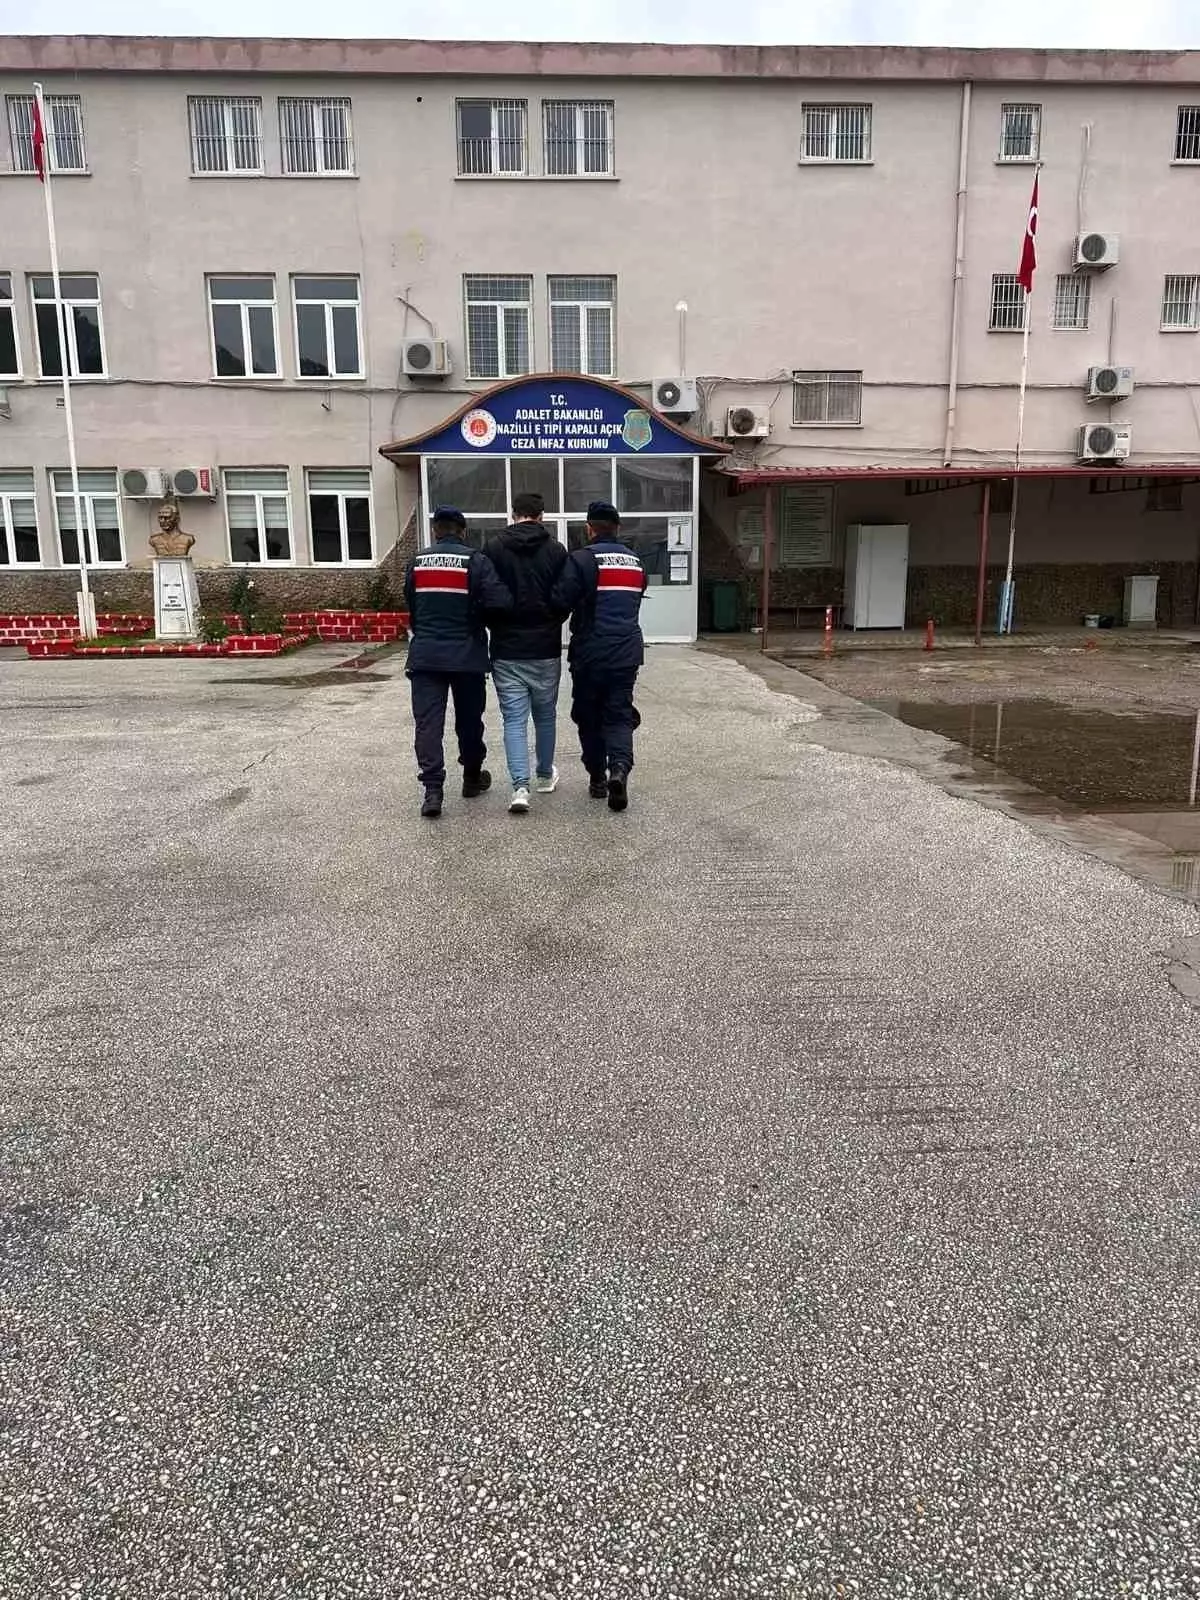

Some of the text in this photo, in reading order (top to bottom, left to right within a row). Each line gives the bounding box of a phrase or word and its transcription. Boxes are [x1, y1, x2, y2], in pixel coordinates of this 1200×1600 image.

[550, 394, 568, 406] T.C.
[515, 407, 603, 420] ADALET BAKANLIĞI
[496, 422, 532, 435] NAZİLLİ
[535, 424, 541, 435] E
[565, 423, 598, 435] KAPALI
[600, 423, 623, 438] AÇIK
[511, 436, 609, 449] CEZA İNFAZ KURUMU
[419, 557, 463, 568] JANDARMA
